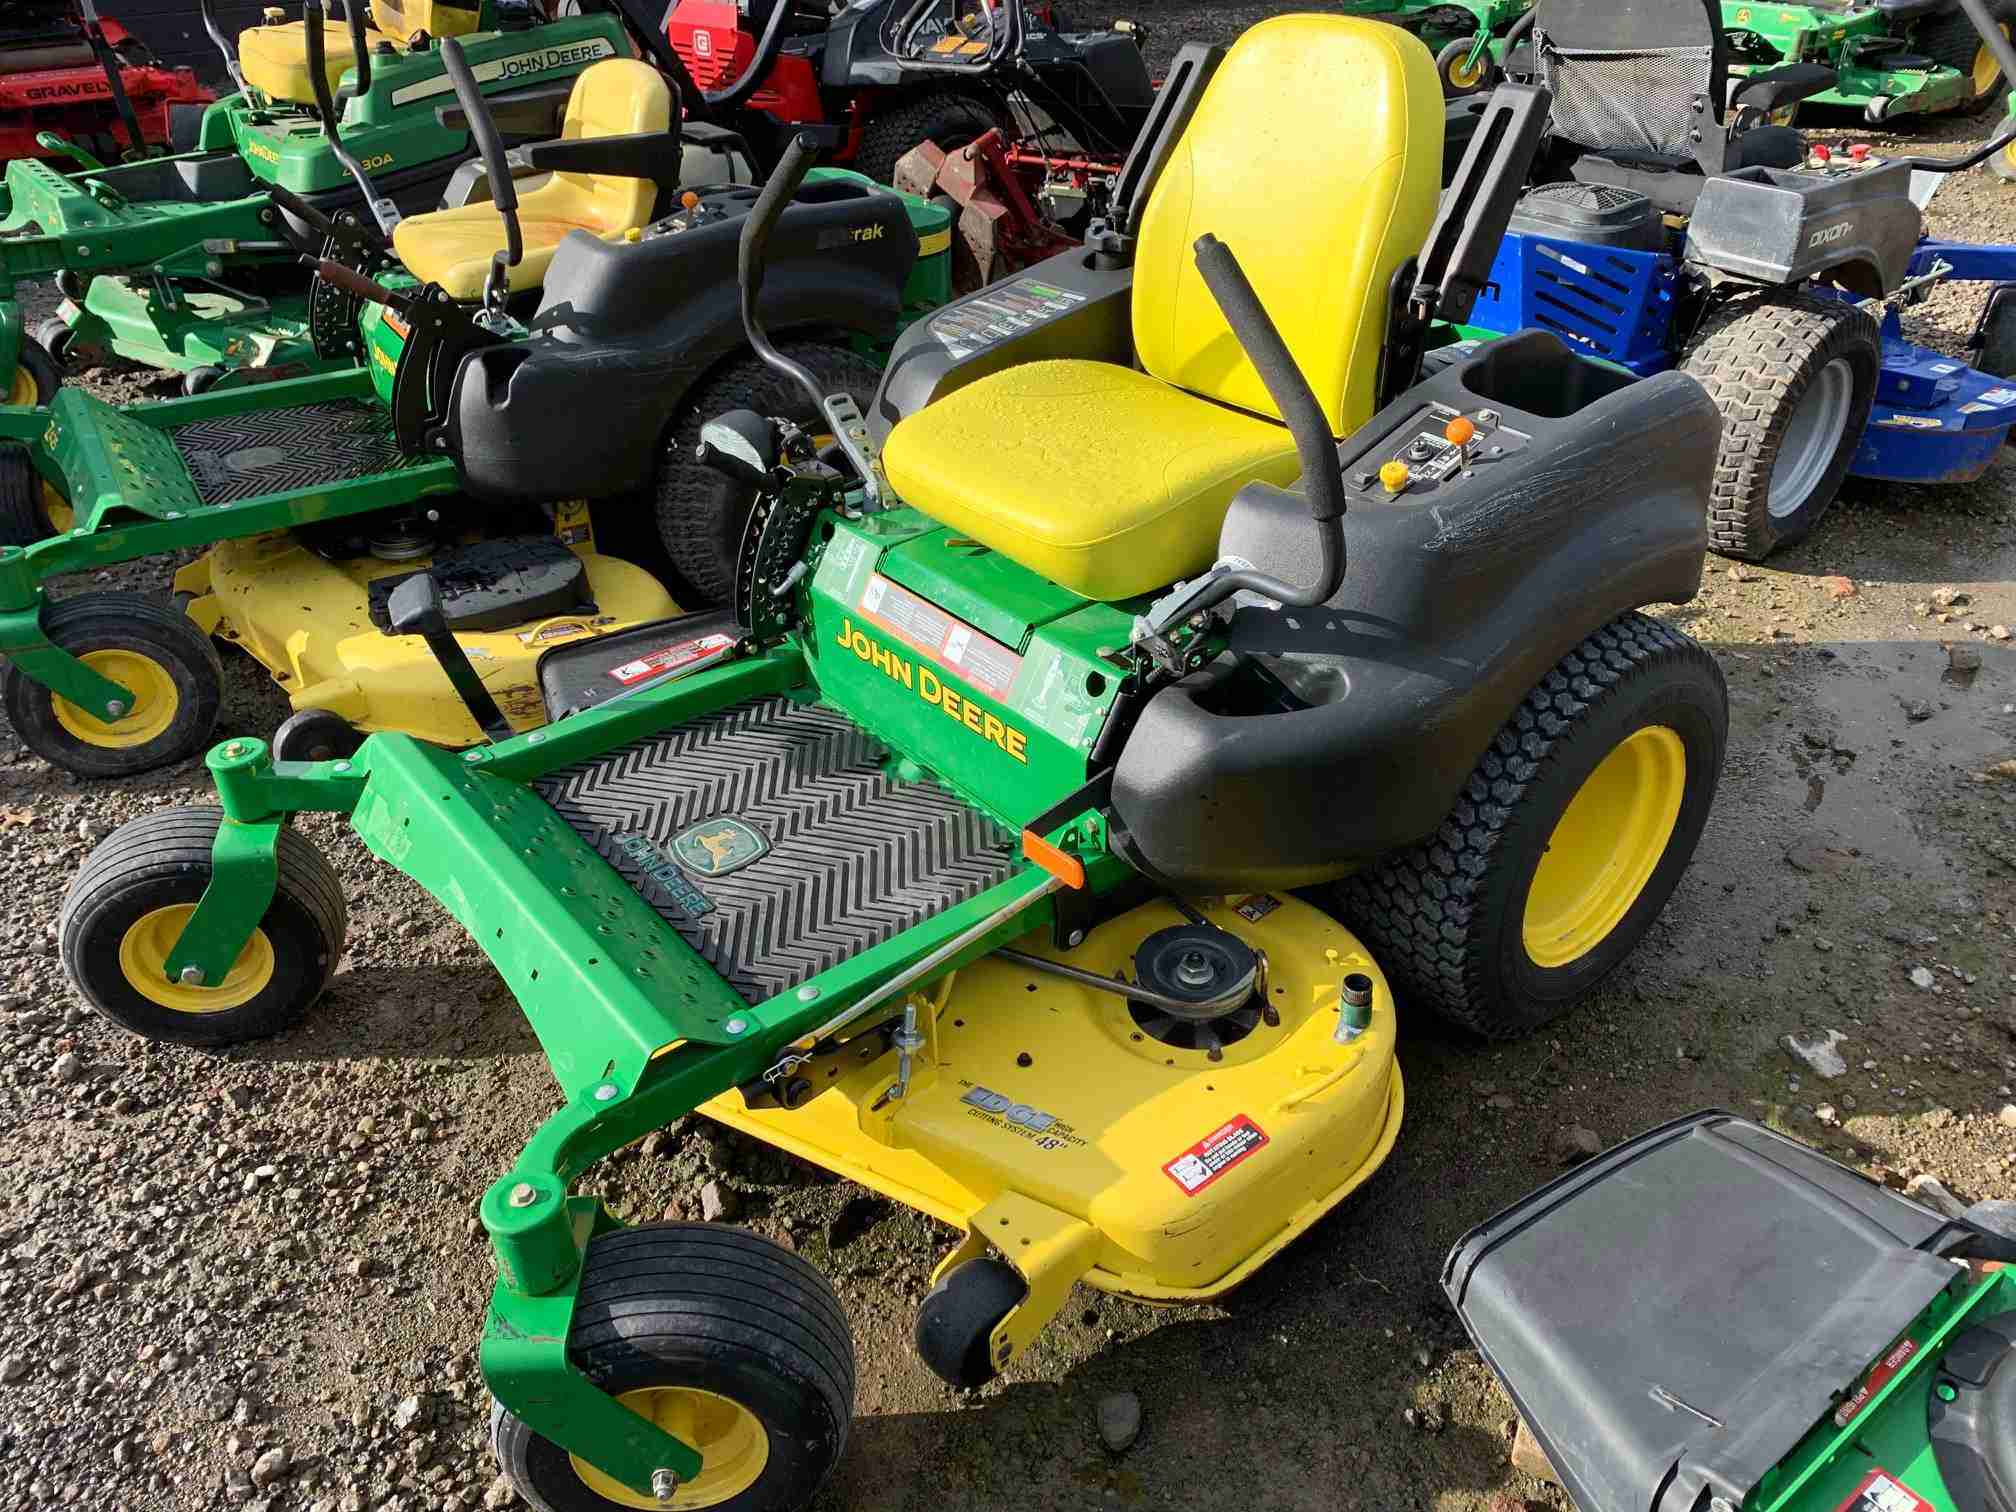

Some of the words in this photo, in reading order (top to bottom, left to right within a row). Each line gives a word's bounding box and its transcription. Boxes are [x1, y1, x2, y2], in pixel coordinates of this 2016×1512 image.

[497, 54, 545, 77] JOHN
[549, 44, 603, 65] DEERE
[341, 152, 395, 177] Z30A
[1808, 222, 1850, 248] DIXON
[837, 617, 913, 691] JOHN
[918, 664, 1028, 765] DEERE
[650, 864, 707, 918] DEERE
[959, 1086, 1057, 1133] EDGE
[967, 1108, 1003, 1128] CUTTING
[1000, 1122, 1037, 1139] SYSTEM
[1046, 1127, 1088, 1147] CAPACITY
